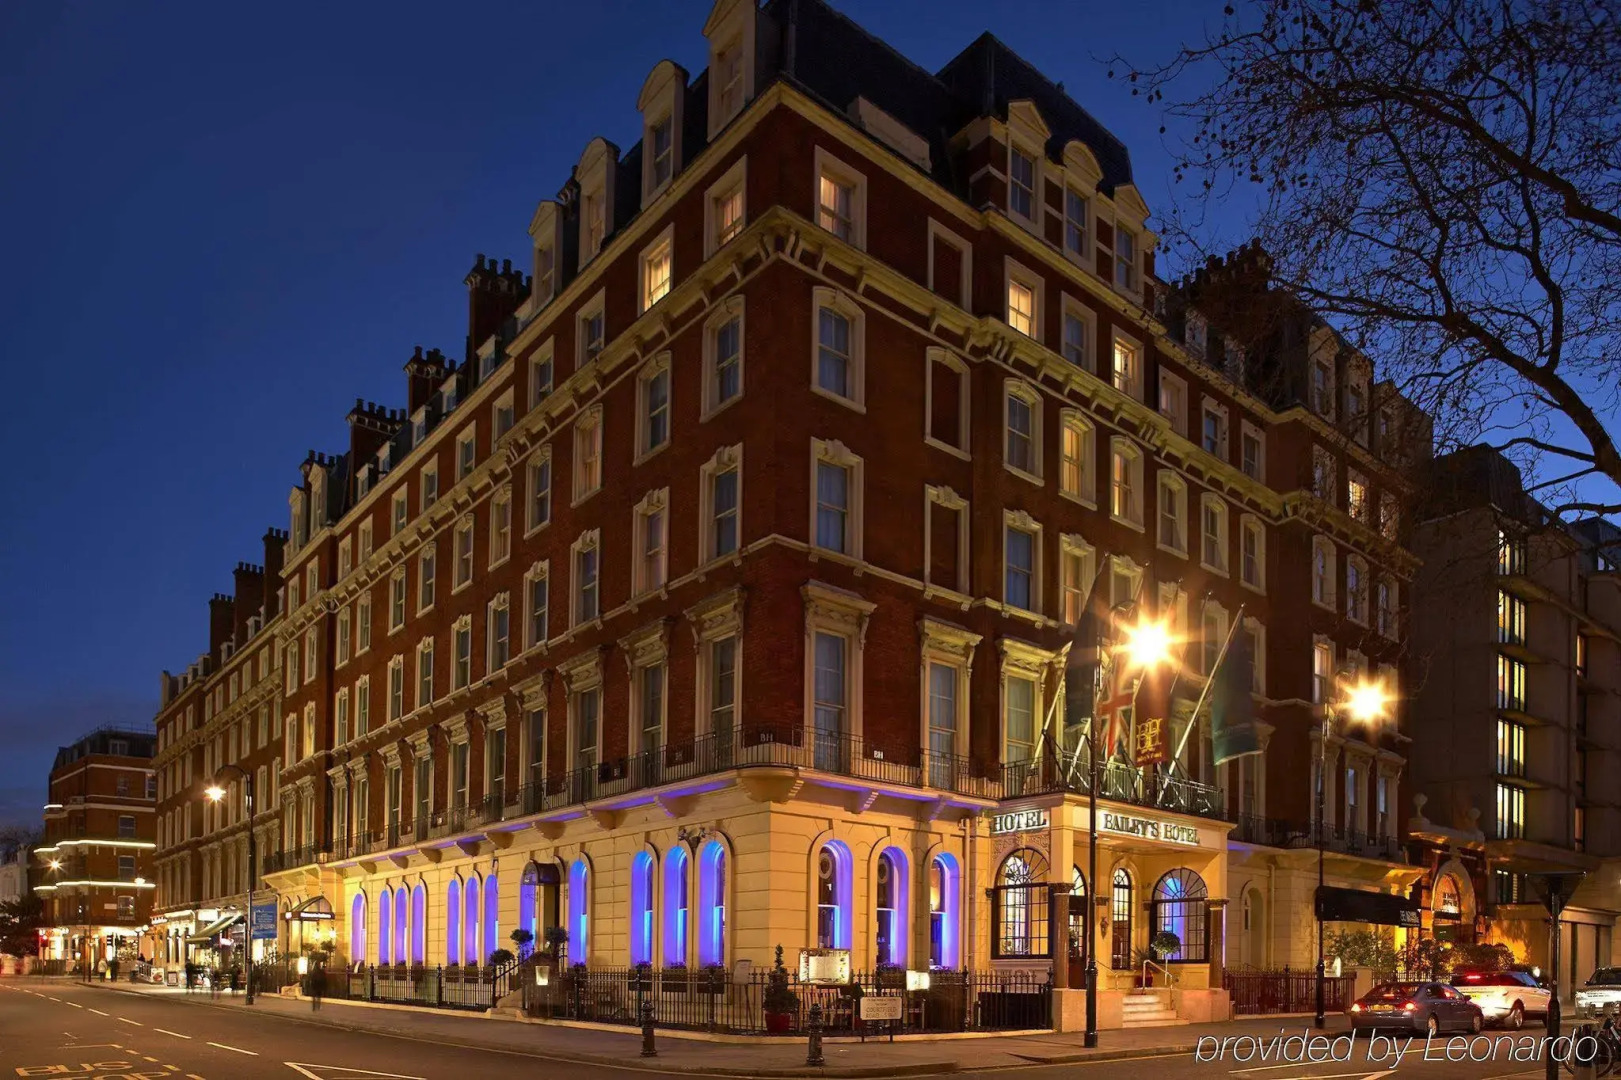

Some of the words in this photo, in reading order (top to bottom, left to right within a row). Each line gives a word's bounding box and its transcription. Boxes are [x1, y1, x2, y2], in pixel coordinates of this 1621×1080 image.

[989, 810, 1047, 832] HOTEL
[1103, 813, 1159, 838] BAILEY'S
[1163, 824, 1200, 844] HOTEL
[15, 1061, 133, 1077] BUS
